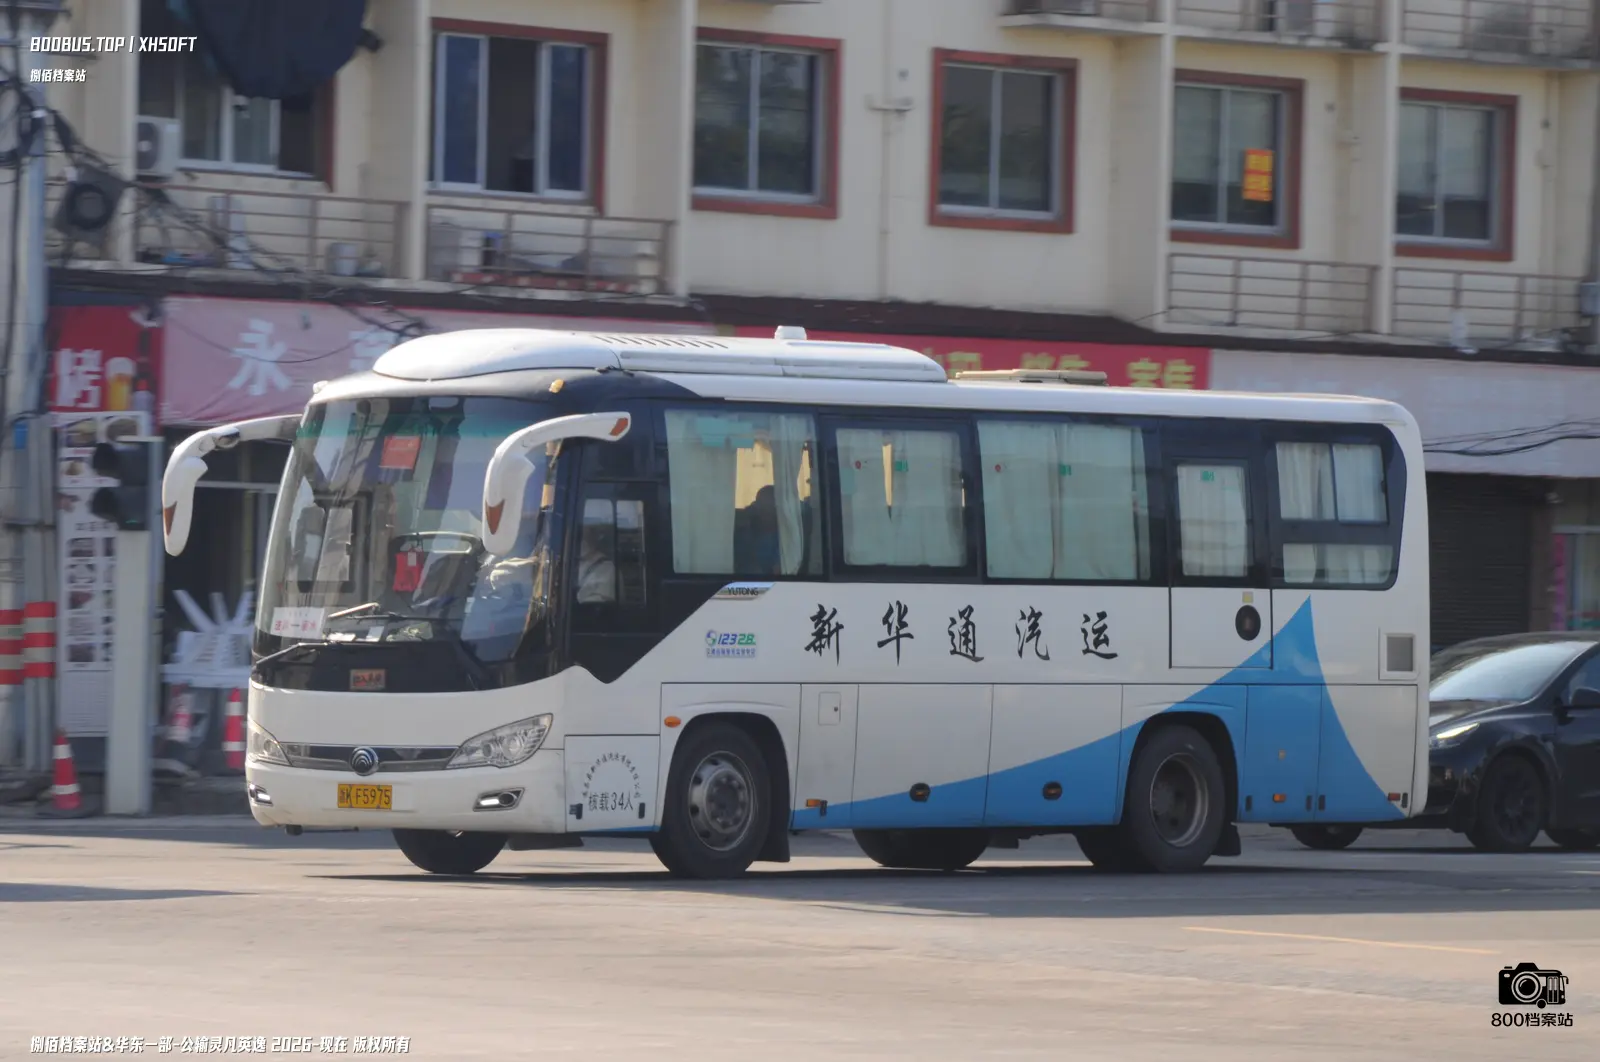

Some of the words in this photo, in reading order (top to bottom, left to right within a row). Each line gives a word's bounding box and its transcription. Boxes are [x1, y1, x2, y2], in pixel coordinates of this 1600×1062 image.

[727, 587, 759, 596] YUTONG
[717, 633, 756, 646] 12328
[803, 600, 1119, 667] 新华通汽运
[588, 791, 634, 812] 核载34人
